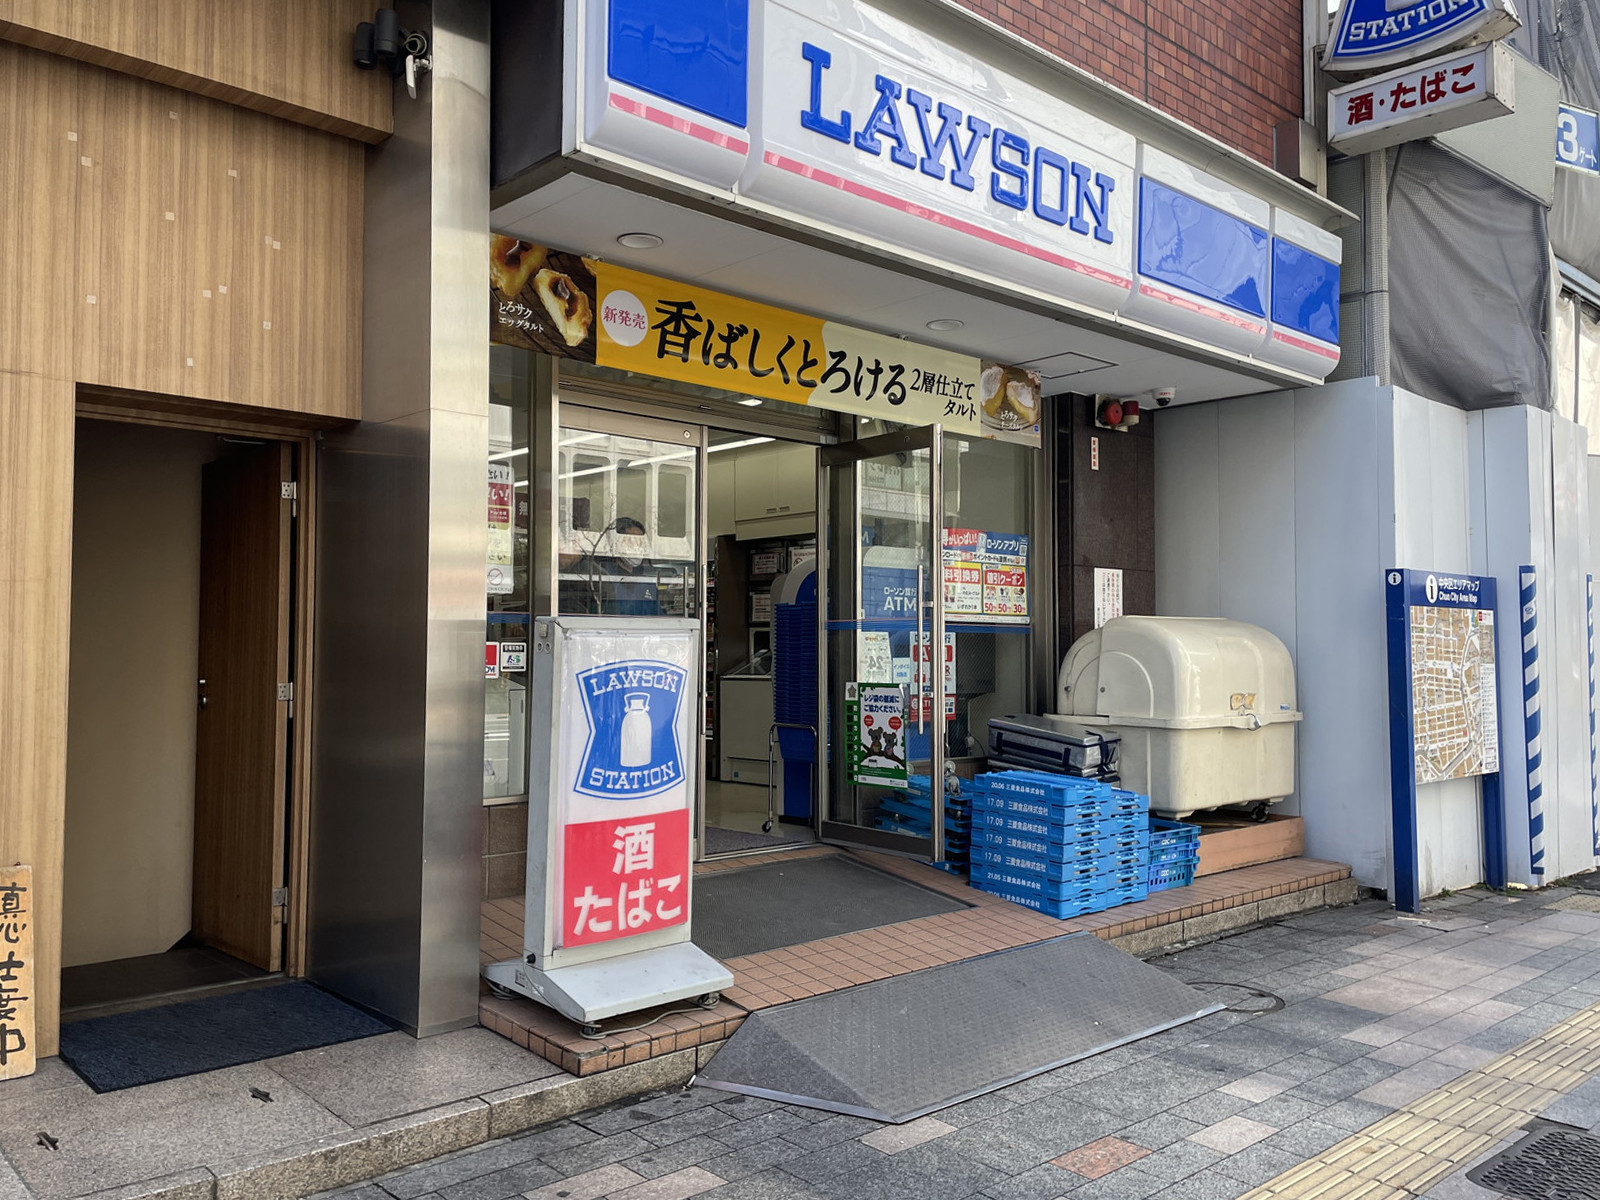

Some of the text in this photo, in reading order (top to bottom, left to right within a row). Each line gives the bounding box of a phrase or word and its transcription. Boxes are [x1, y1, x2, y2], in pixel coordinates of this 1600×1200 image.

[1347, 63, 1475, 125] 酒・たばこ
[801, 42, 1115, 244] LAWSON
[499, 301, 532, 319] とろサク
[603, 306, 646, 330] 新発売
[499, 316, 544, 333] エッグタルト
[651, 300, 907, 405] 香ばしくとろける
[910, 368, 975, 401] 2層仕立て
[943, 400, 977, 422] タルト
[986, 539, 1019, 551] ローソンアプリ
[1439, 577, 1480, 591] 中央区エリアマップ
[884, 596, 917, 611] ATM
[1451, 592, 1459, 604] City
[590, 670, 680, 696] LAWSON
[590, 761, 676, 789] STATION
[1006, 785, 1045, 796] 三菱食品株式会社
[987, 798, 1048, 816] 17.09 三菱食品株式会社
[986, 816, 1048, 834] 17.09 三菱食品株式会社
[612, 822, 656, 875] 酒
[986, 834, 1047, 853] 17.09 三菱食品株式会社
[984, 852, 1046, 872] 17.09 三菱食品株式会社
[1002, 876, 1041, 889] 三菱食品株式会社
[573, 874, 681, 936] たばこ
